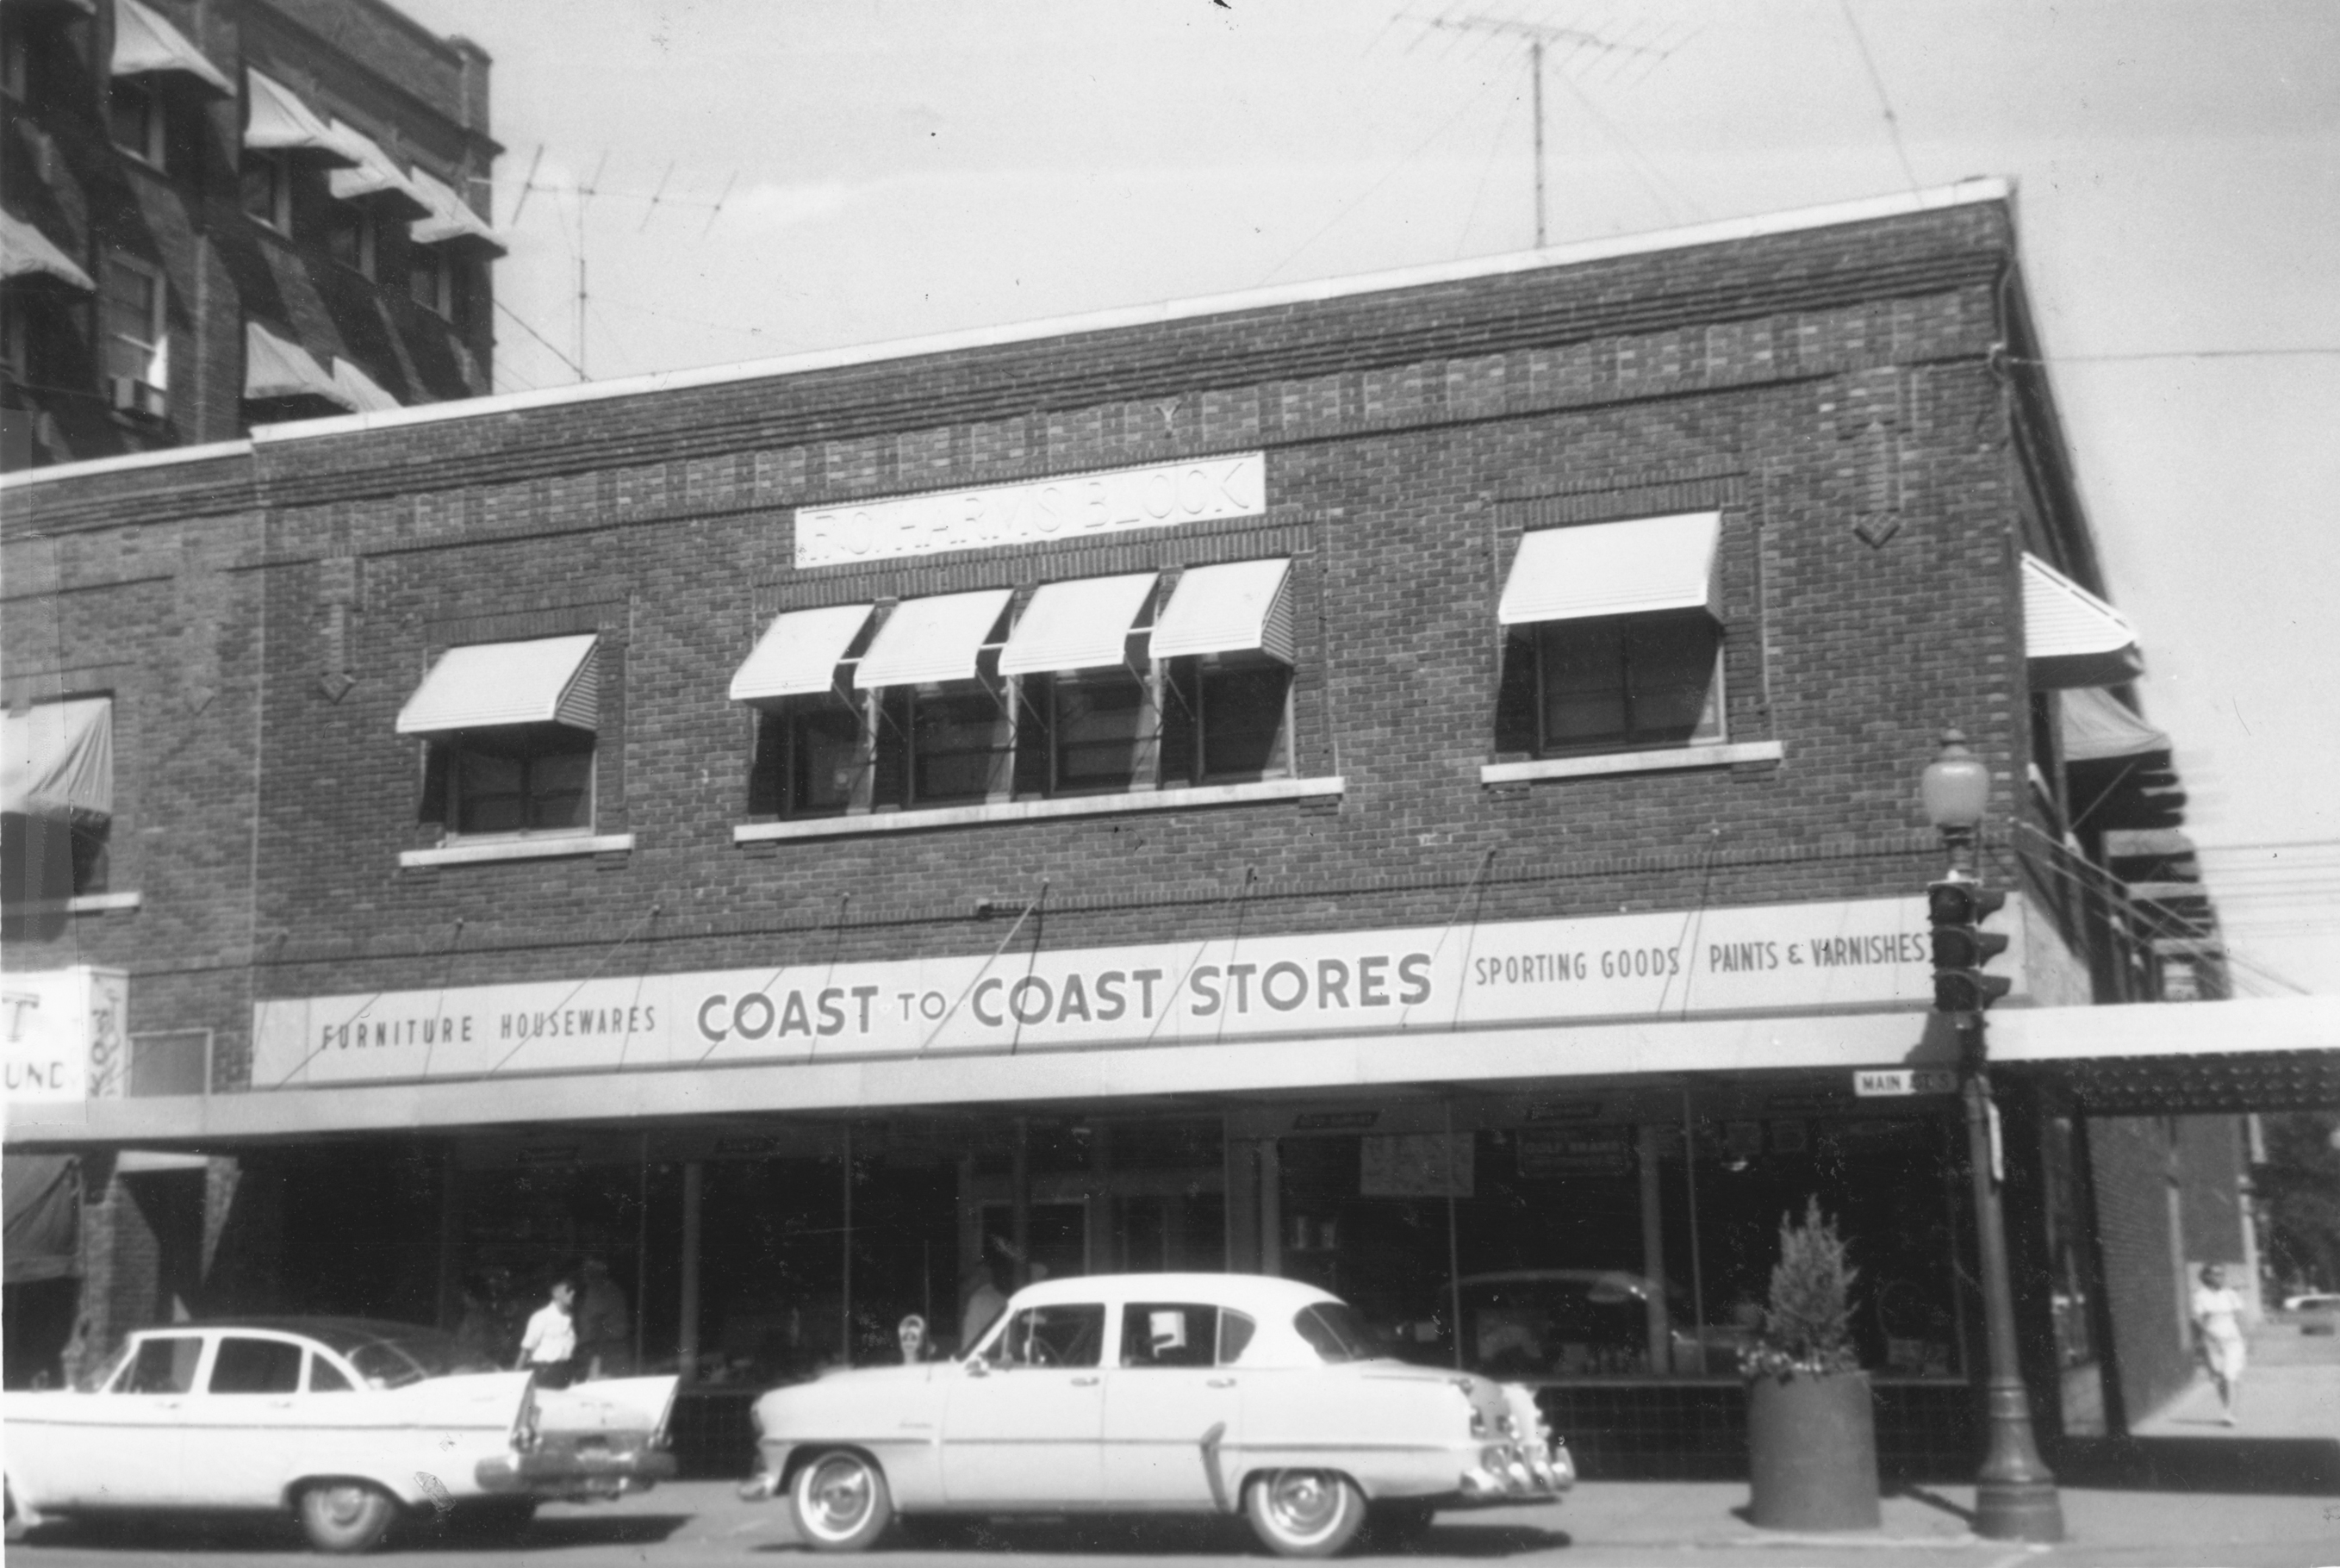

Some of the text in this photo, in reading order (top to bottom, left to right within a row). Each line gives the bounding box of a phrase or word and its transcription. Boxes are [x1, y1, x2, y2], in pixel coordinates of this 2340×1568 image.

[1083, 461, 1252, 528] BLOCK
[1475, 947, 1679, 985] SPORTING GOODS
[1709, 932, 1926, 973] PAINTS & VARNISHES
[697, 953, 1431, 1042] COAST TO COAST STORES
[321, 1005, 656, 1050] FURNITURE HOUSEWARES
[1862, 1075, 1901, 1091] MAIN
